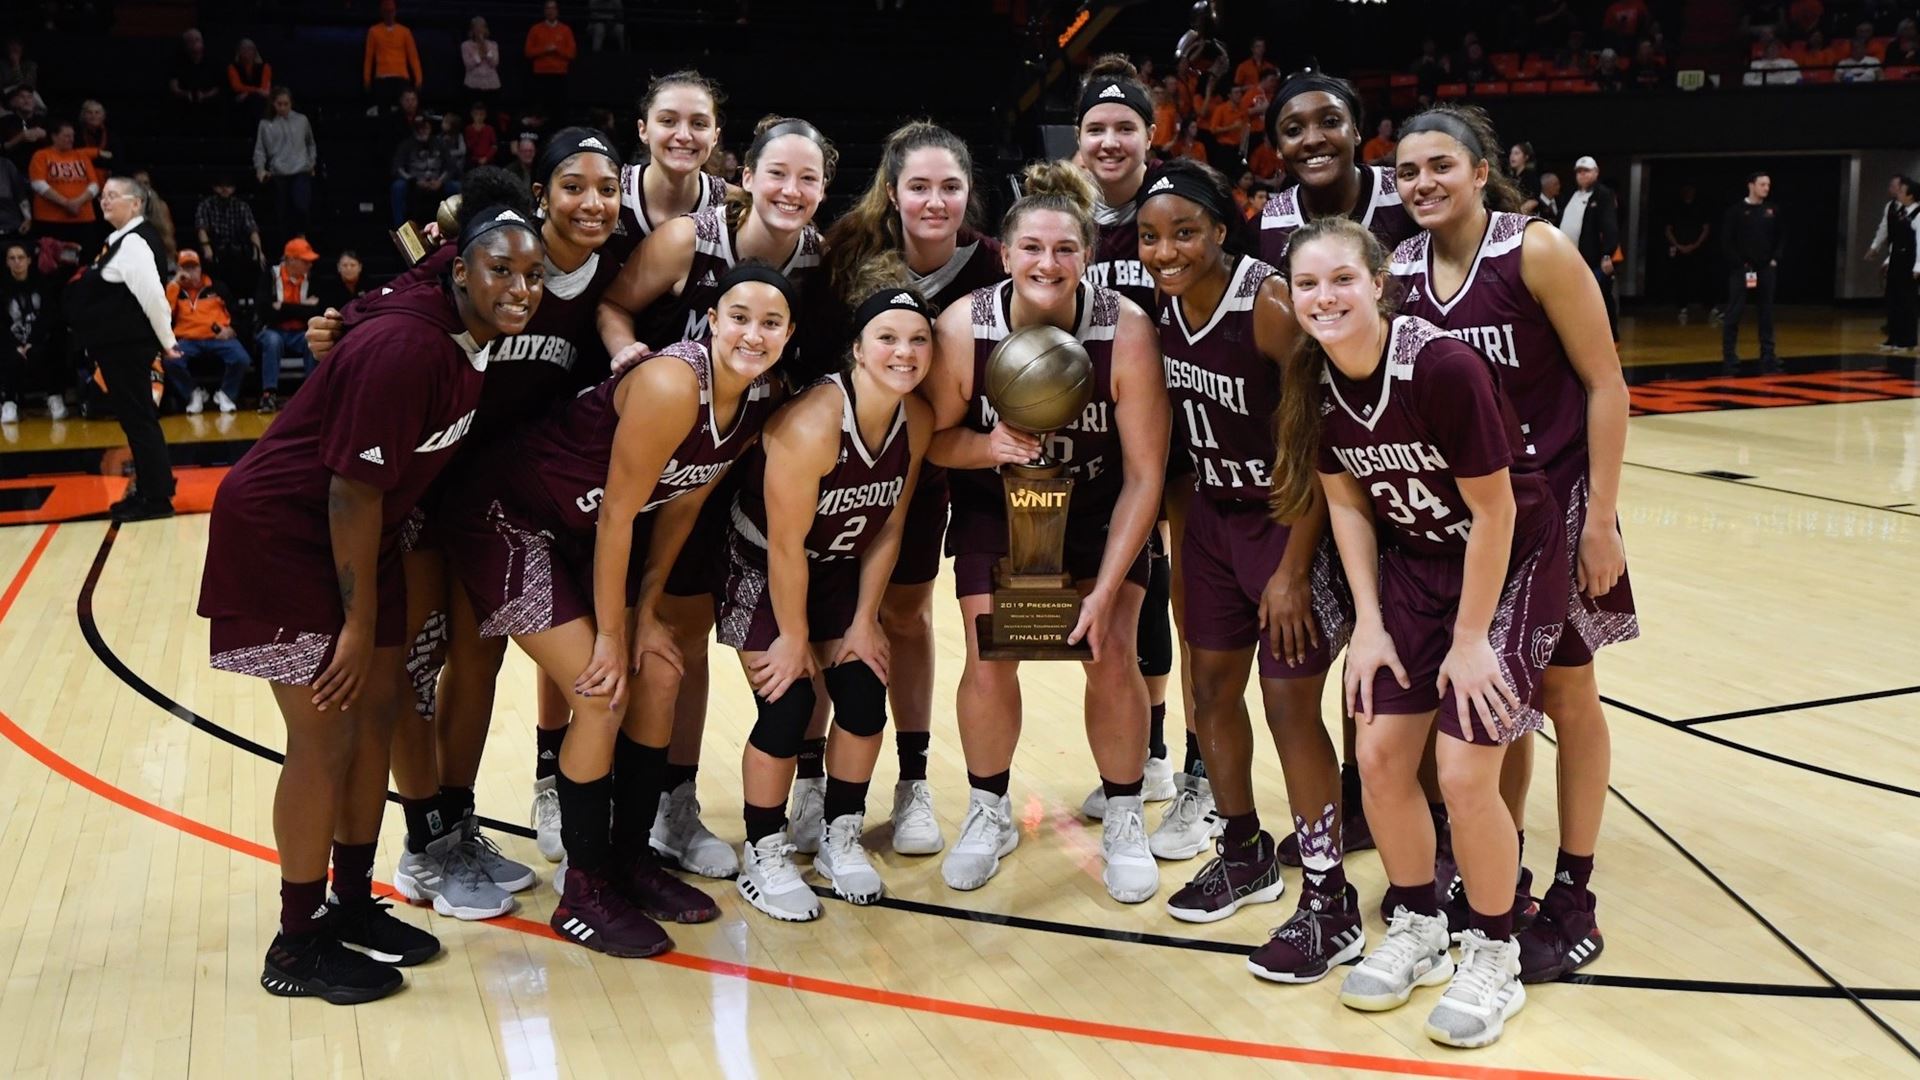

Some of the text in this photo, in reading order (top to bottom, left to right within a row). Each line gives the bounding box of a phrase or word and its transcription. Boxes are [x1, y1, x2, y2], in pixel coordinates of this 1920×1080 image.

[47, 160, 87, 178] OSU
[1114, 260, 1155, 289] BEA
[1161, 353, 1249, 416] ISSOURI
[1182, 399, 1219, 449] 11
[816, 476, 904, 517] MISSOUR
[1010, 489, 1067, 507] WNIT
[1370, 477, 1451, 524] 34
[828, 515, 868, 551] 2
